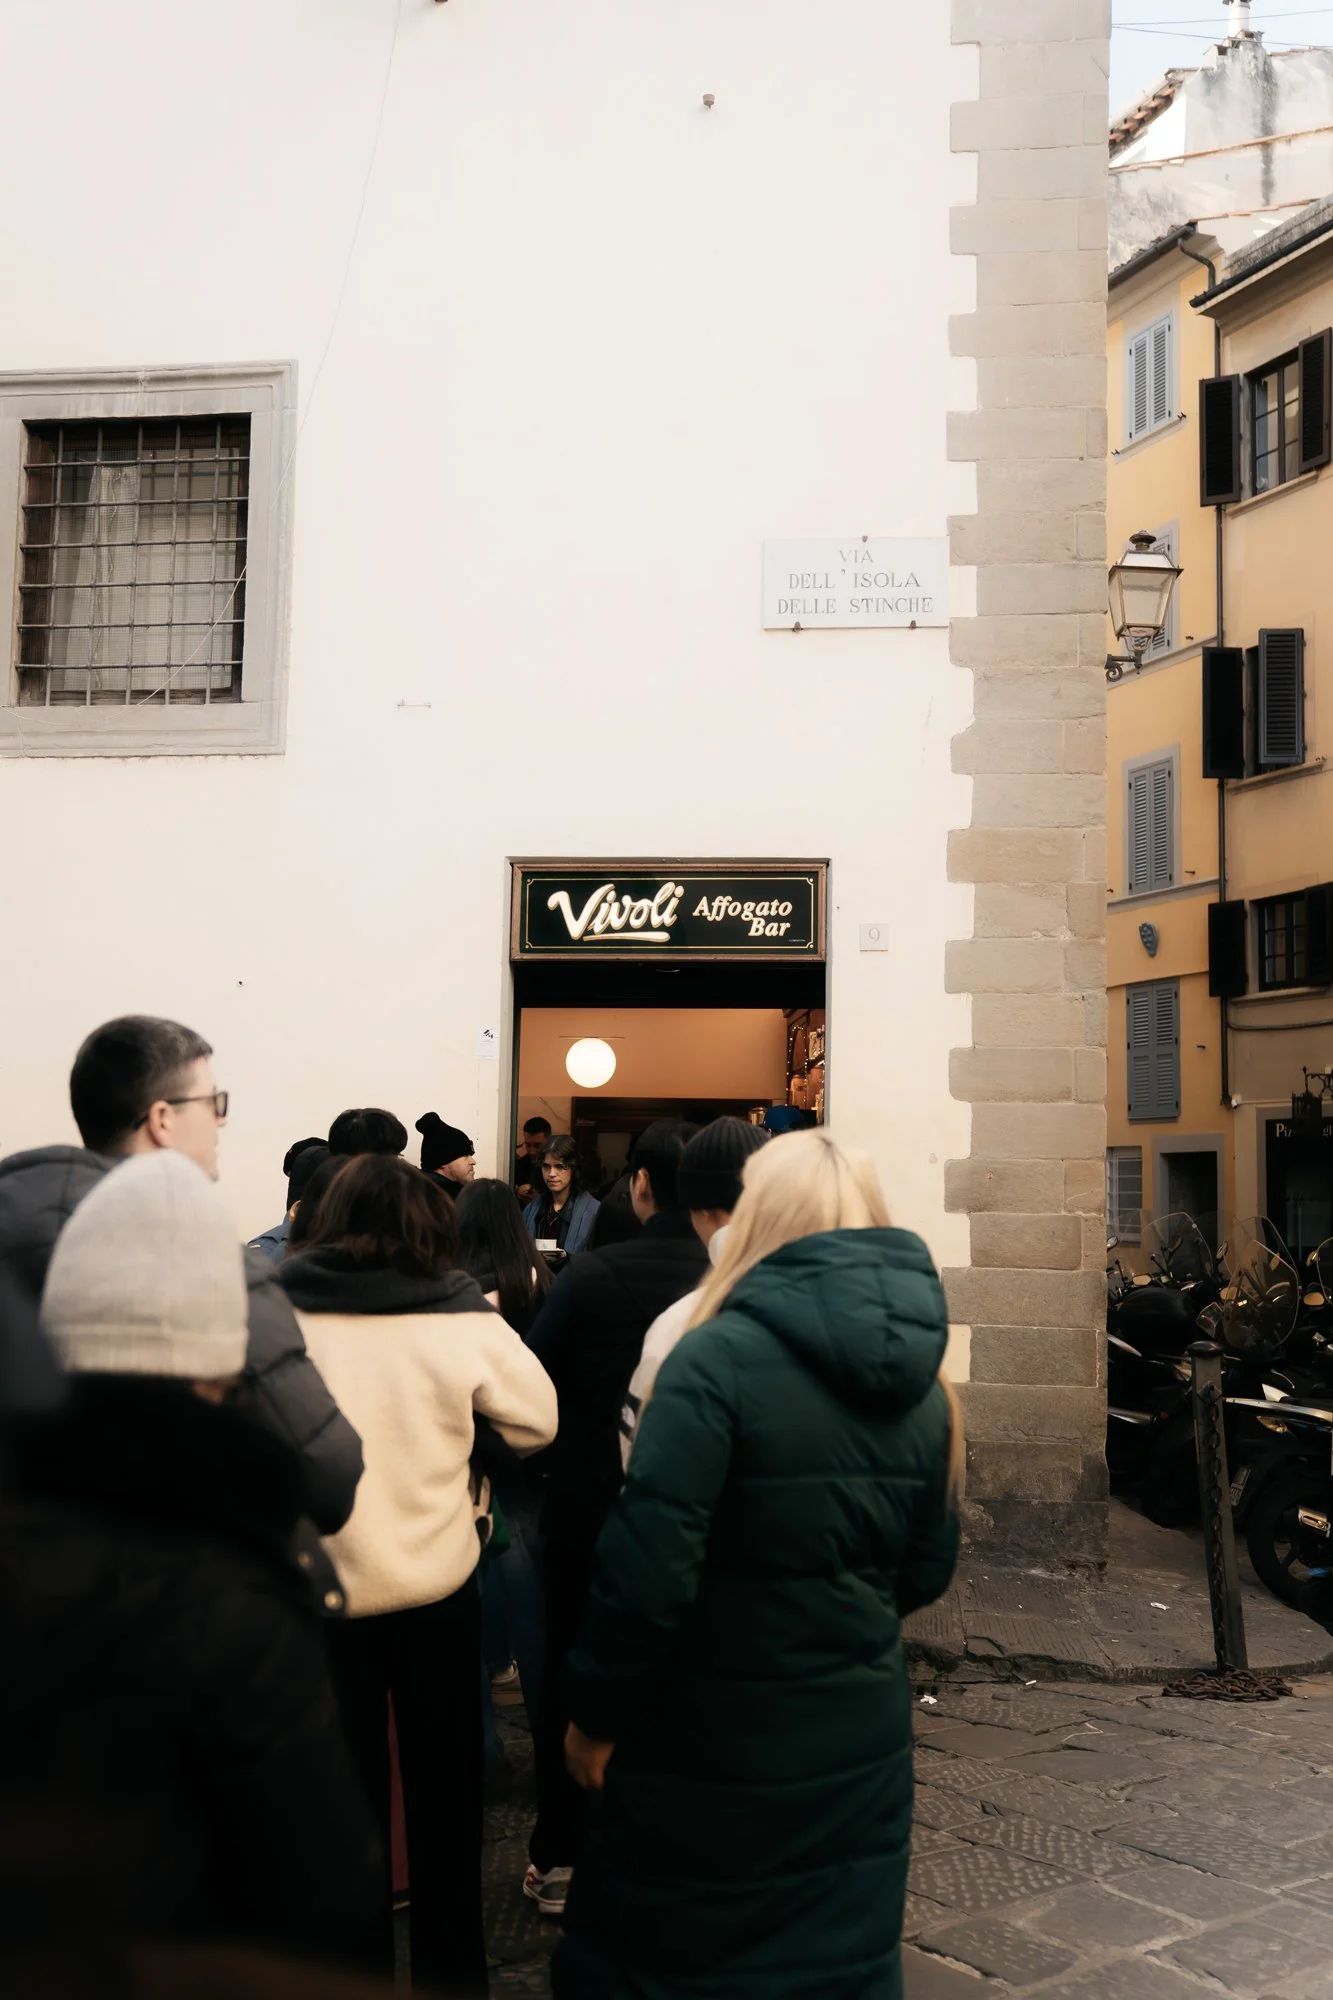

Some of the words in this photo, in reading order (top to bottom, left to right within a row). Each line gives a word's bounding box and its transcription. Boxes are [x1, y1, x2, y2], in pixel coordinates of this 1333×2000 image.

[838, 549, 874, 564] VIA
[777, 598, 836, 614] DELLE
[849, 597, 933, 614] STINCHE
[547, 881, 685, 941] Vivoli
[692, 895, 793, 921] Affogato
[748, 917, 791, 937] Bar
